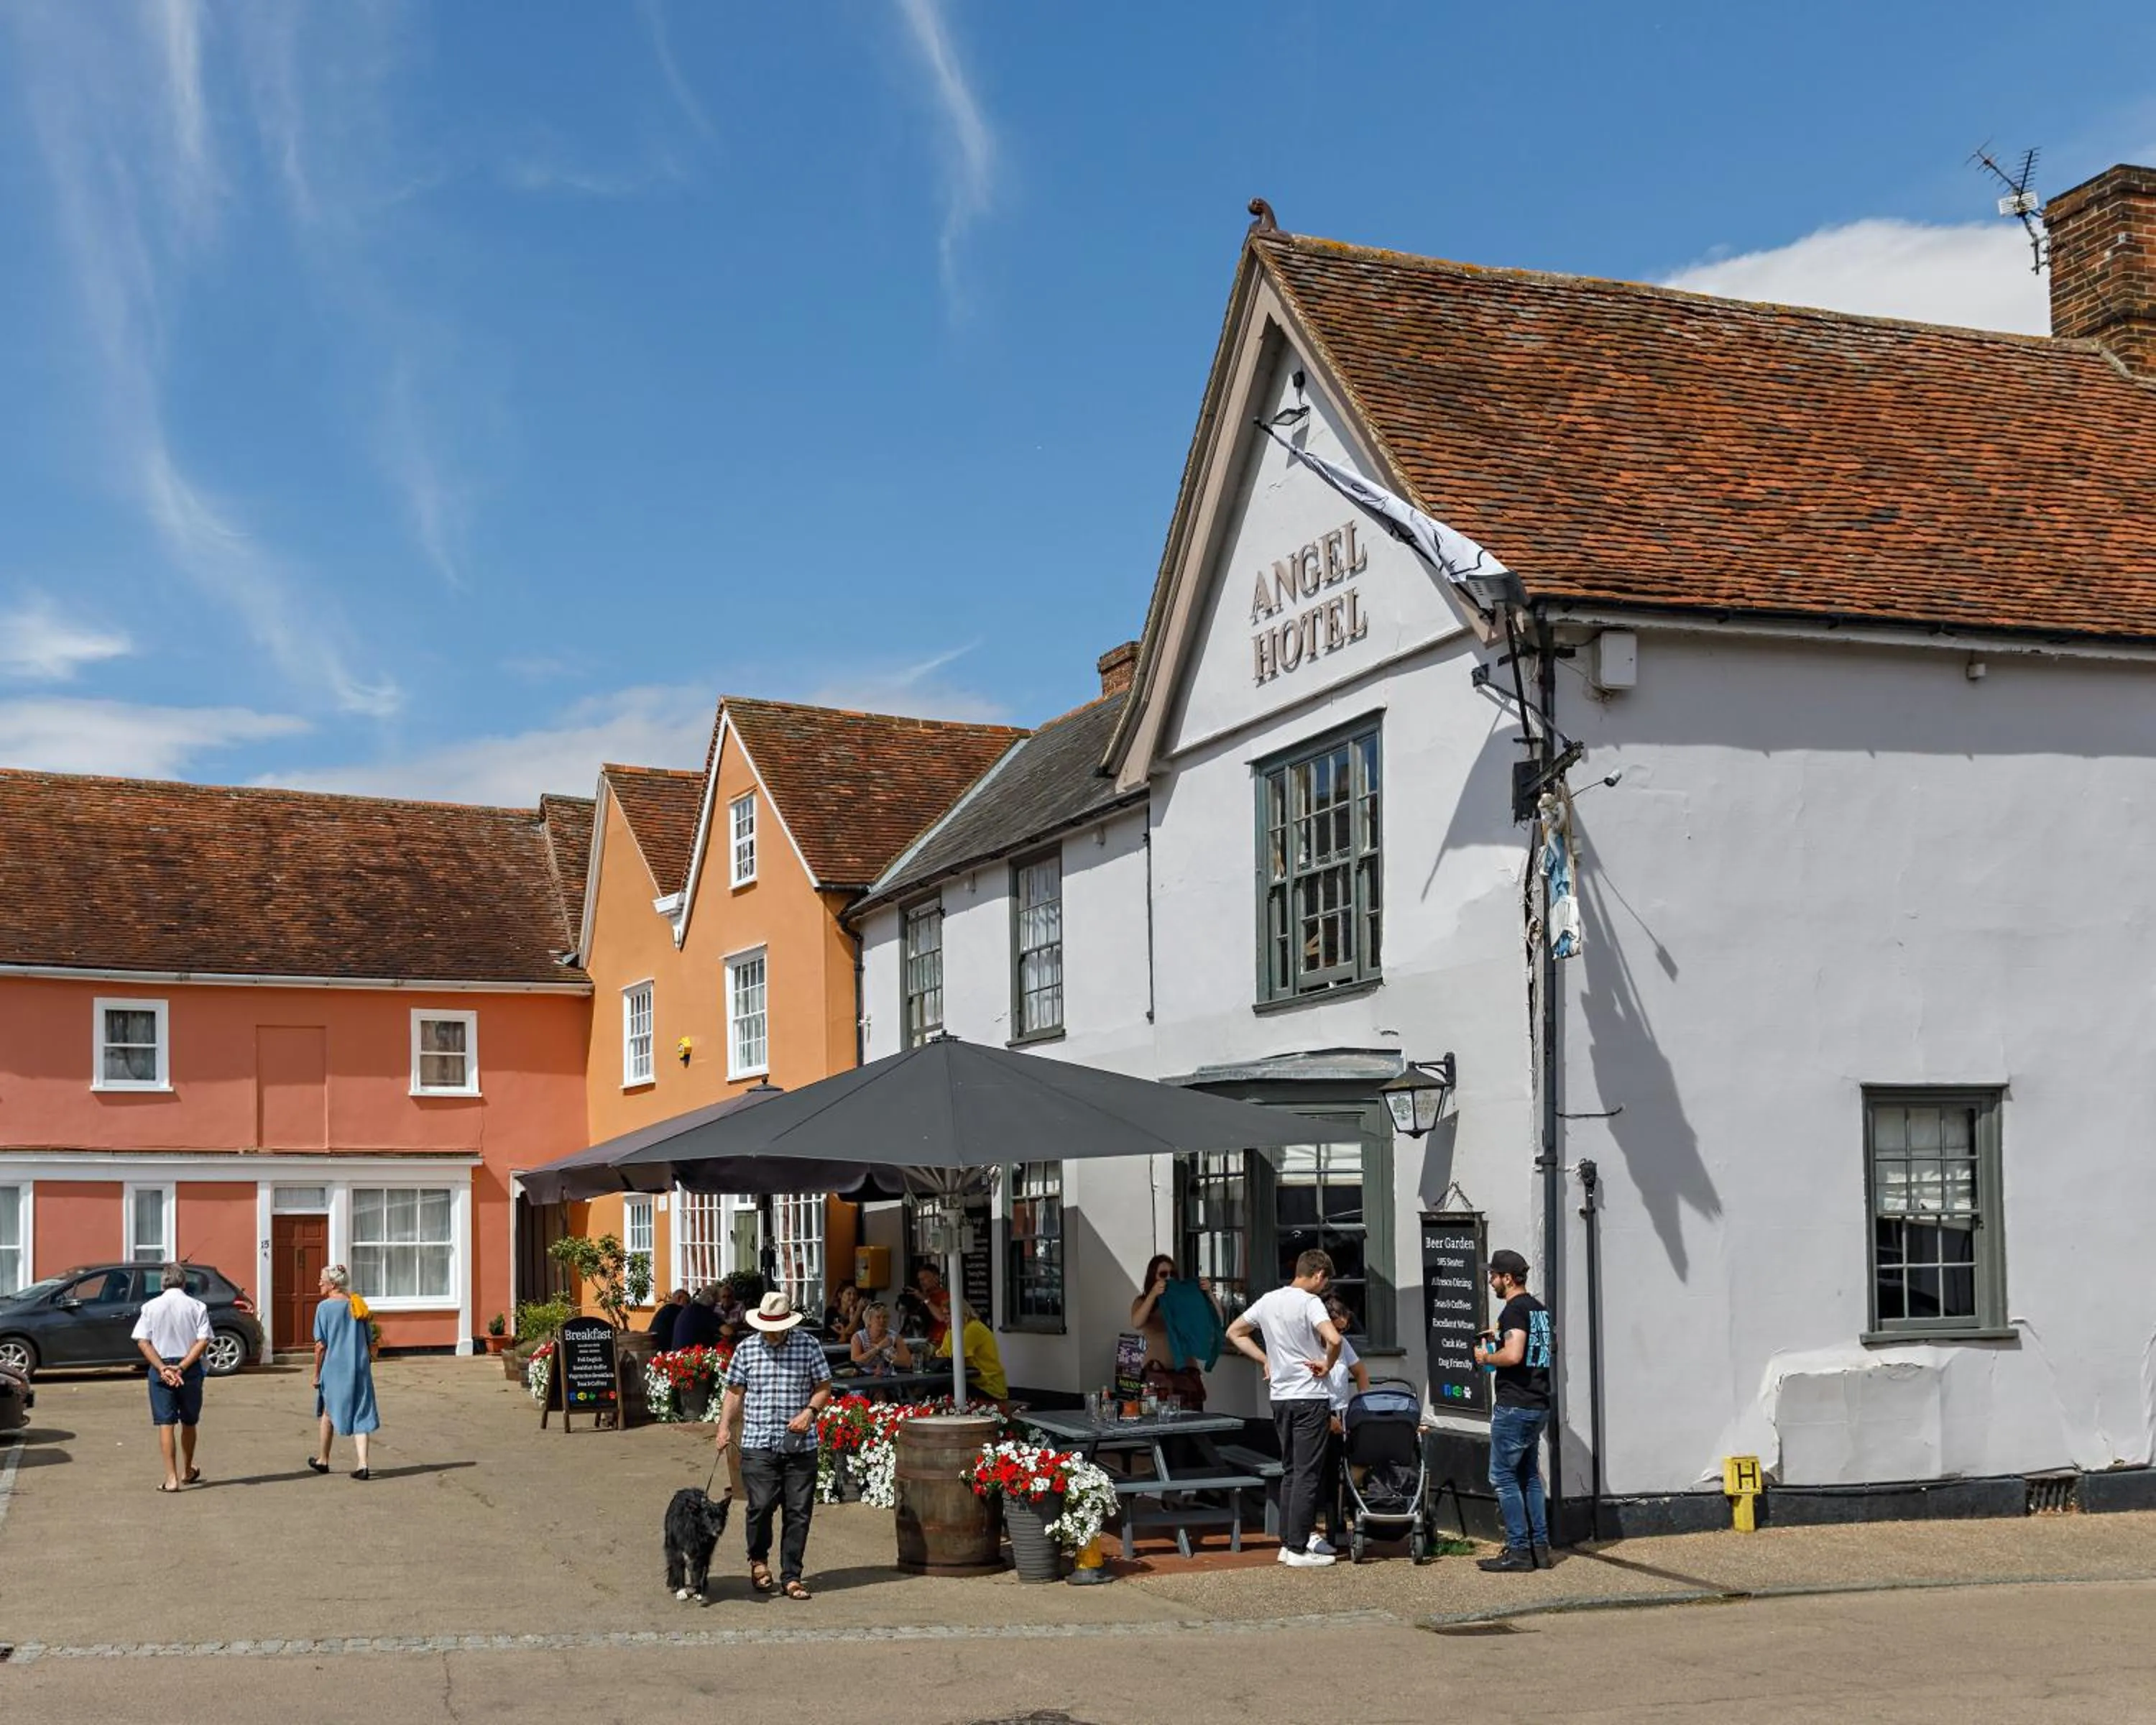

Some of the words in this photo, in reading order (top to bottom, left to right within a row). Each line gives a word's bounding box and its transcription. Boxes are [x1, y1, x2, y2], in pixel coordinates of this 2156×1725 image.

[1250, 520, 1367, 624] ANGEL
[1251, 586, 1368, 688] HOTEL
[1426, 1237, 1443, 1248] Beer
[1445, 1236, 1475, 1249] Garden
[1452, 1277, 1472, 1289] Dining
[564, 1328, 612, 1340] Breakfast
[1438, 1358, 1450, 1368] Dog
[1450, 1358, 1473, 1371] Friendly
[1737, 1462, 1757, 1489] H
